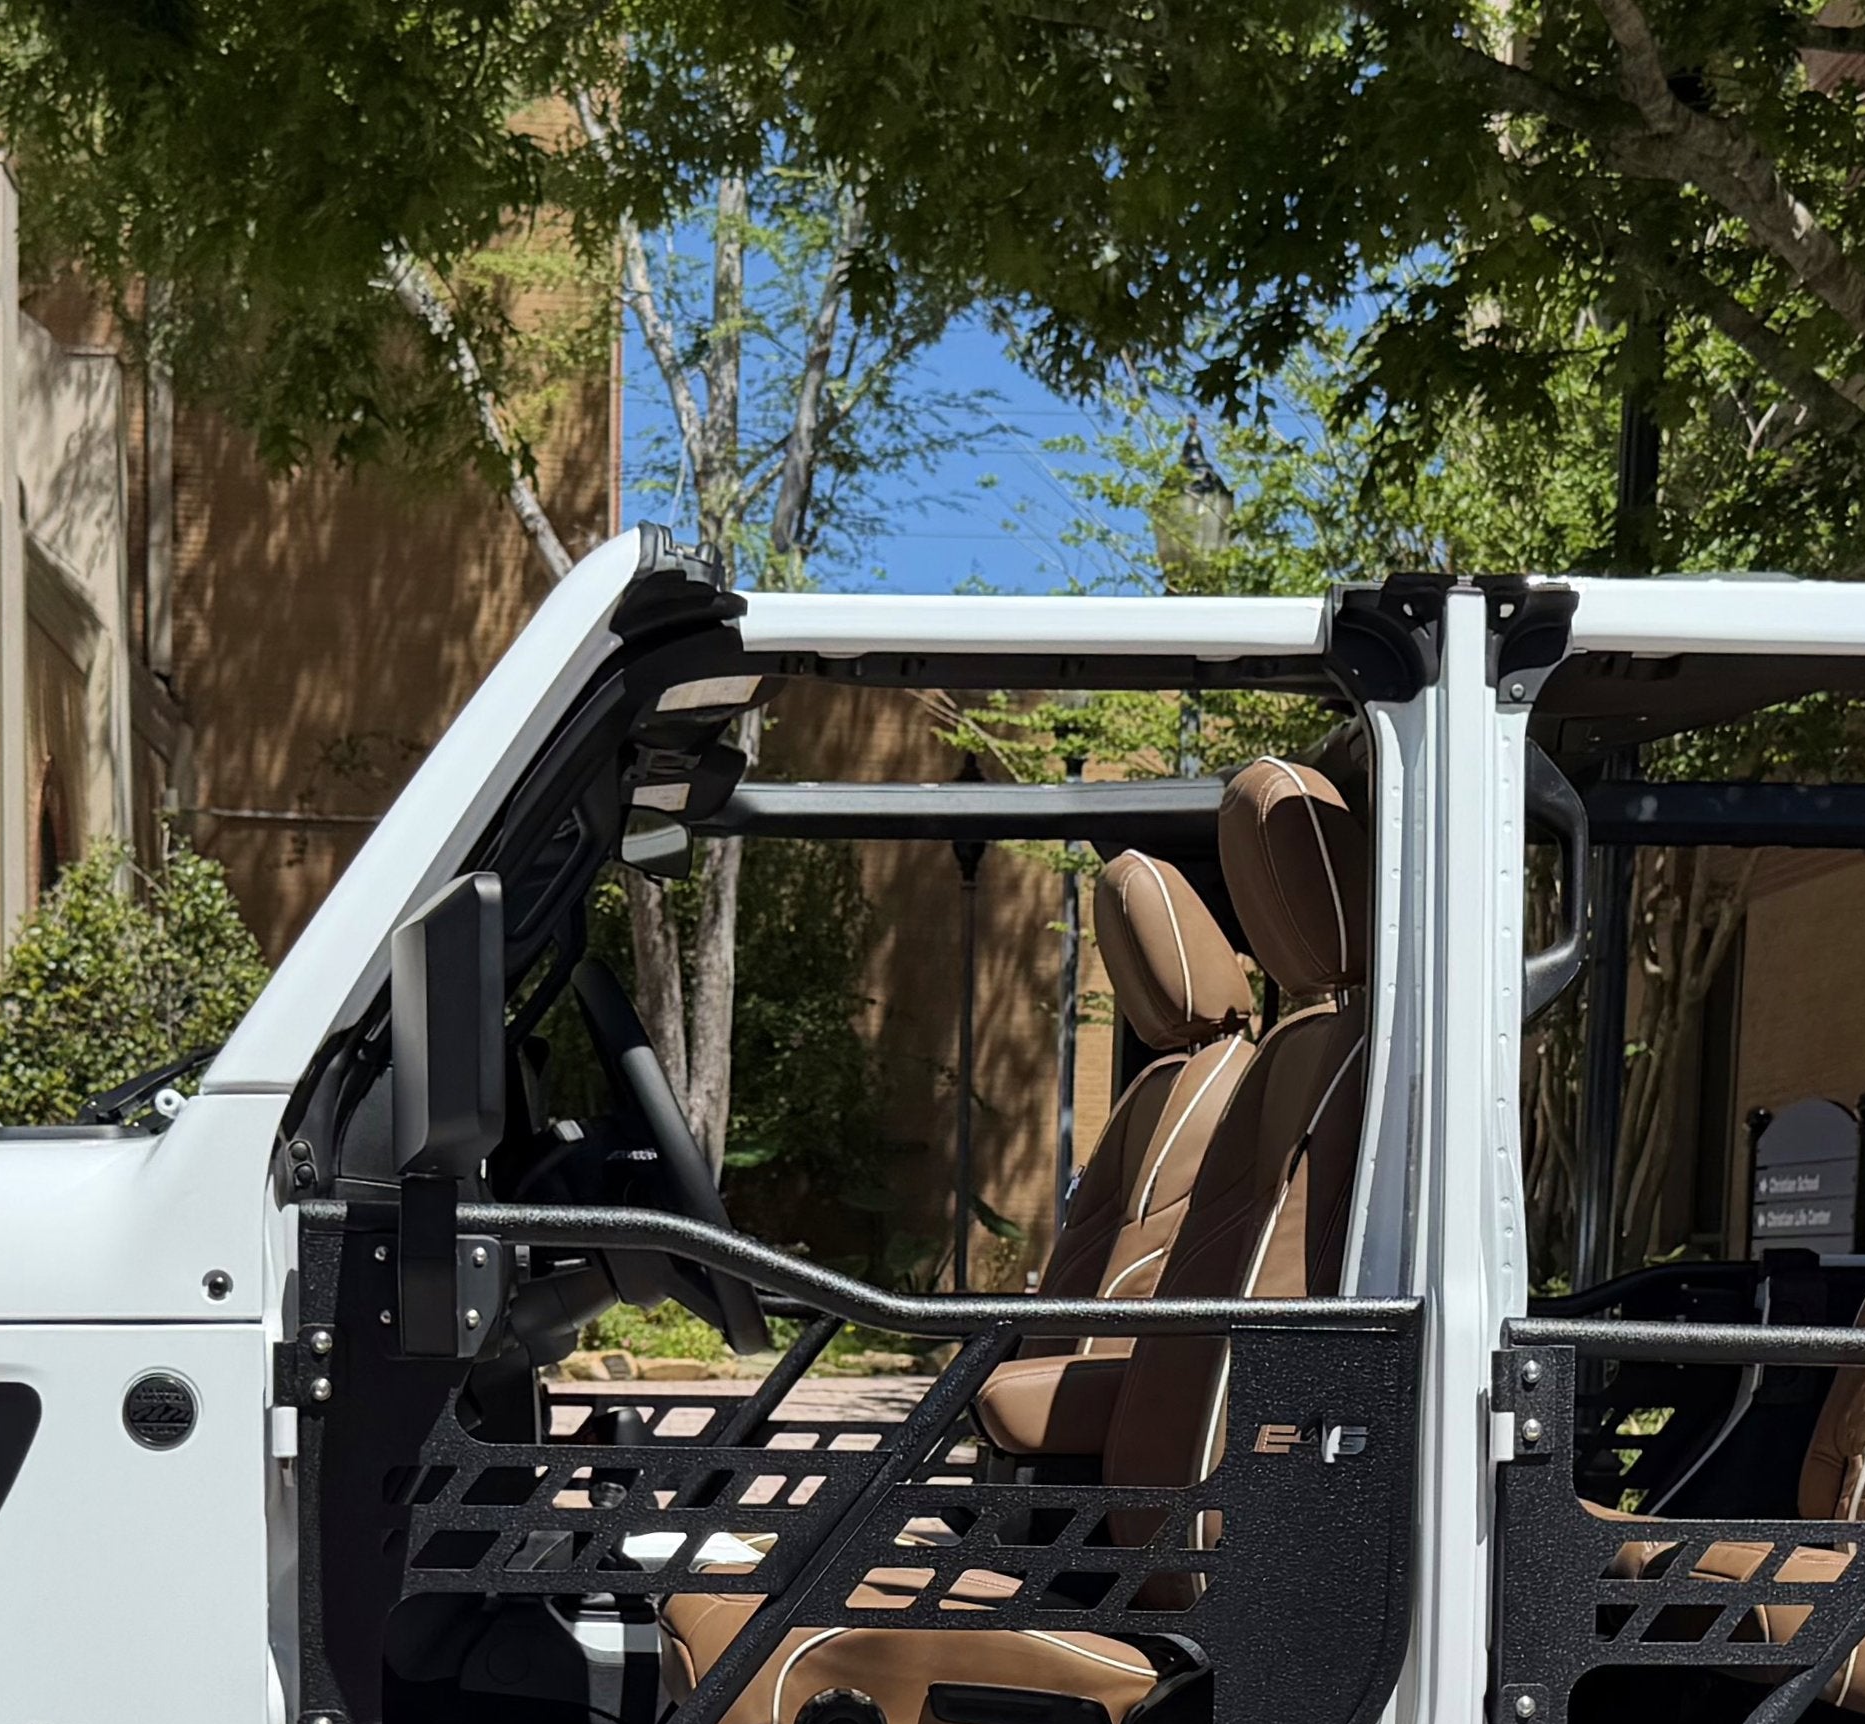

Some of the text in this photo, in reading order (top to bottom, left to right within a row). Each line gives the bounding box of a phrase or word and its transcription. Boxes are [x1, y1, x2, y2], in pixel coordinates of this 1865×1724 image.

[1769, 1173, 1820, 1194] Christian School
[1766, 1210, 1794, 1228] Christian
[1808, 1208, 1831, 1226] Center
